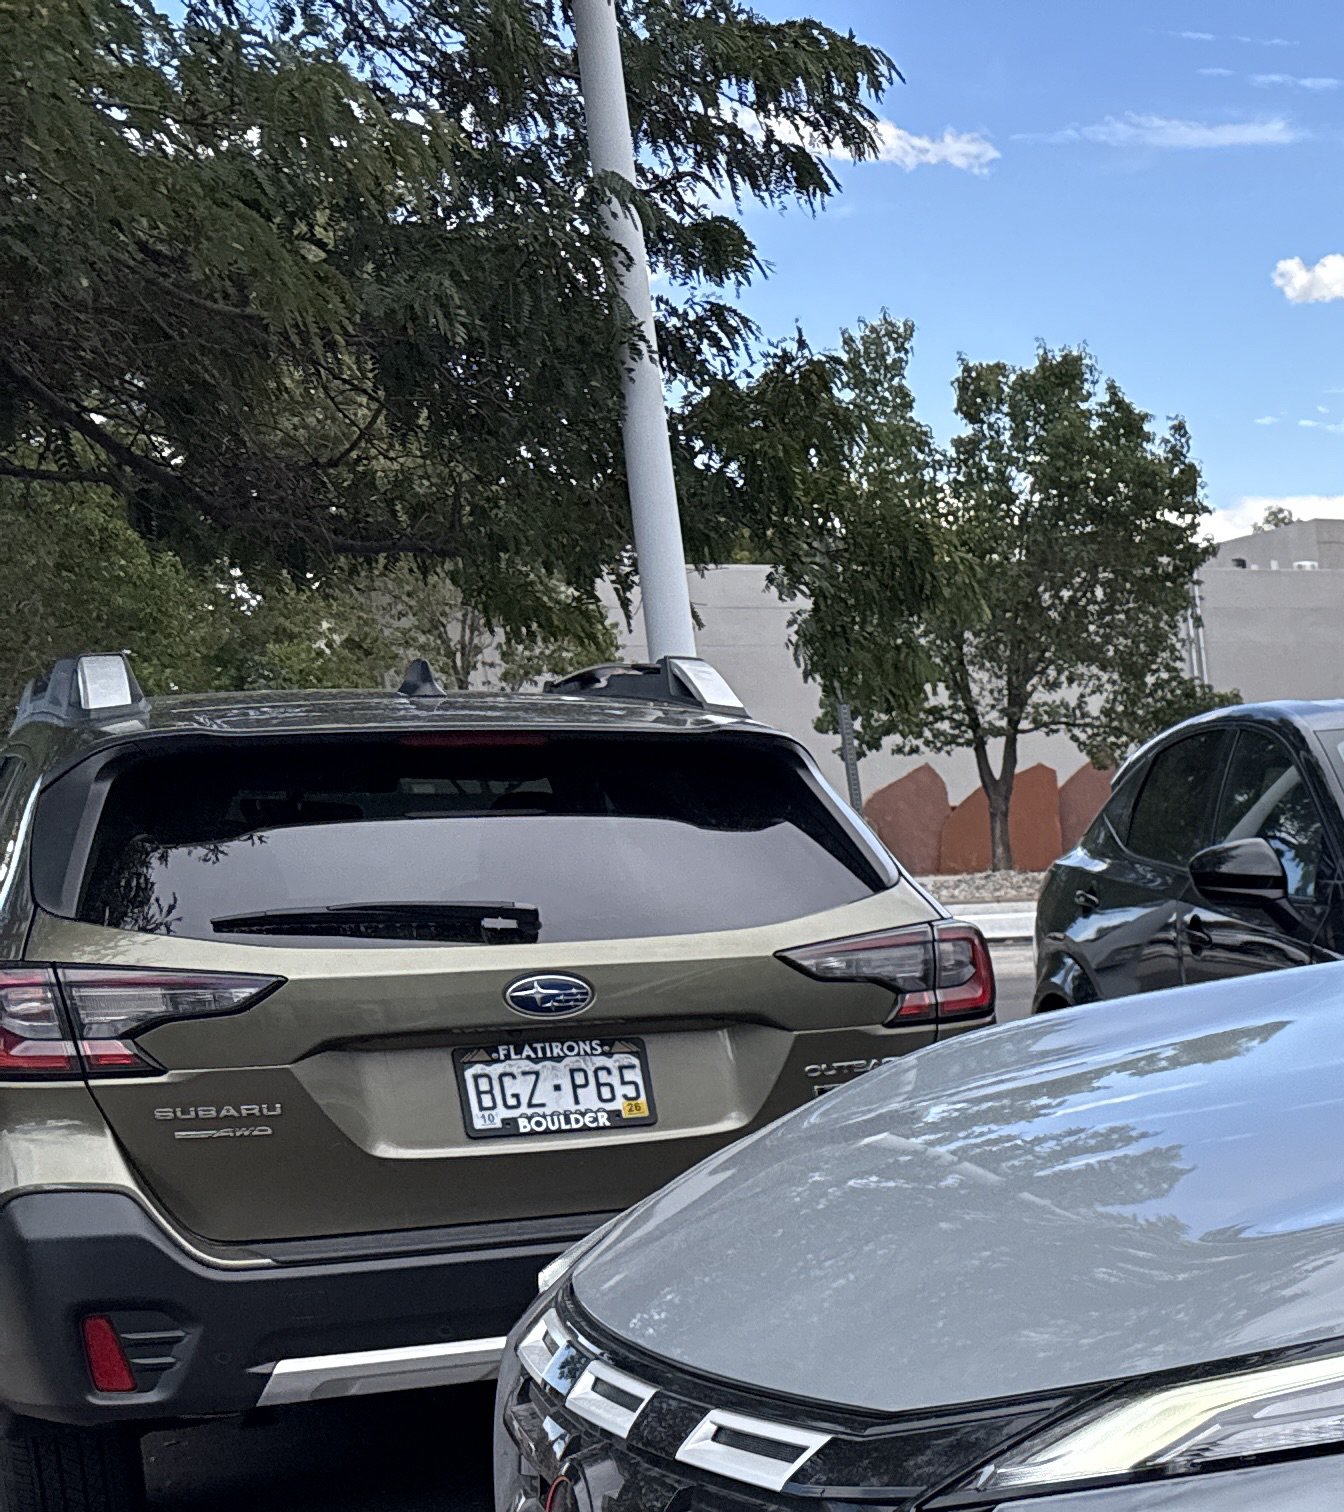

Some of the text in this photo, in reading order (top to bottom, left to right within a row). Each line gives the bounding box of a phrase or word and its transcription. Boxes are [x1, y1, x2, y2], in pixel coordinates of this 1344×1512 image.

[498, 1040, 603, 1060] FLATIRONS
[153, 1103, 282, 1120] SUBARU
[627, 1102, 642, 1113] 26
[518, 1112, 611, 1133] BOULDER
